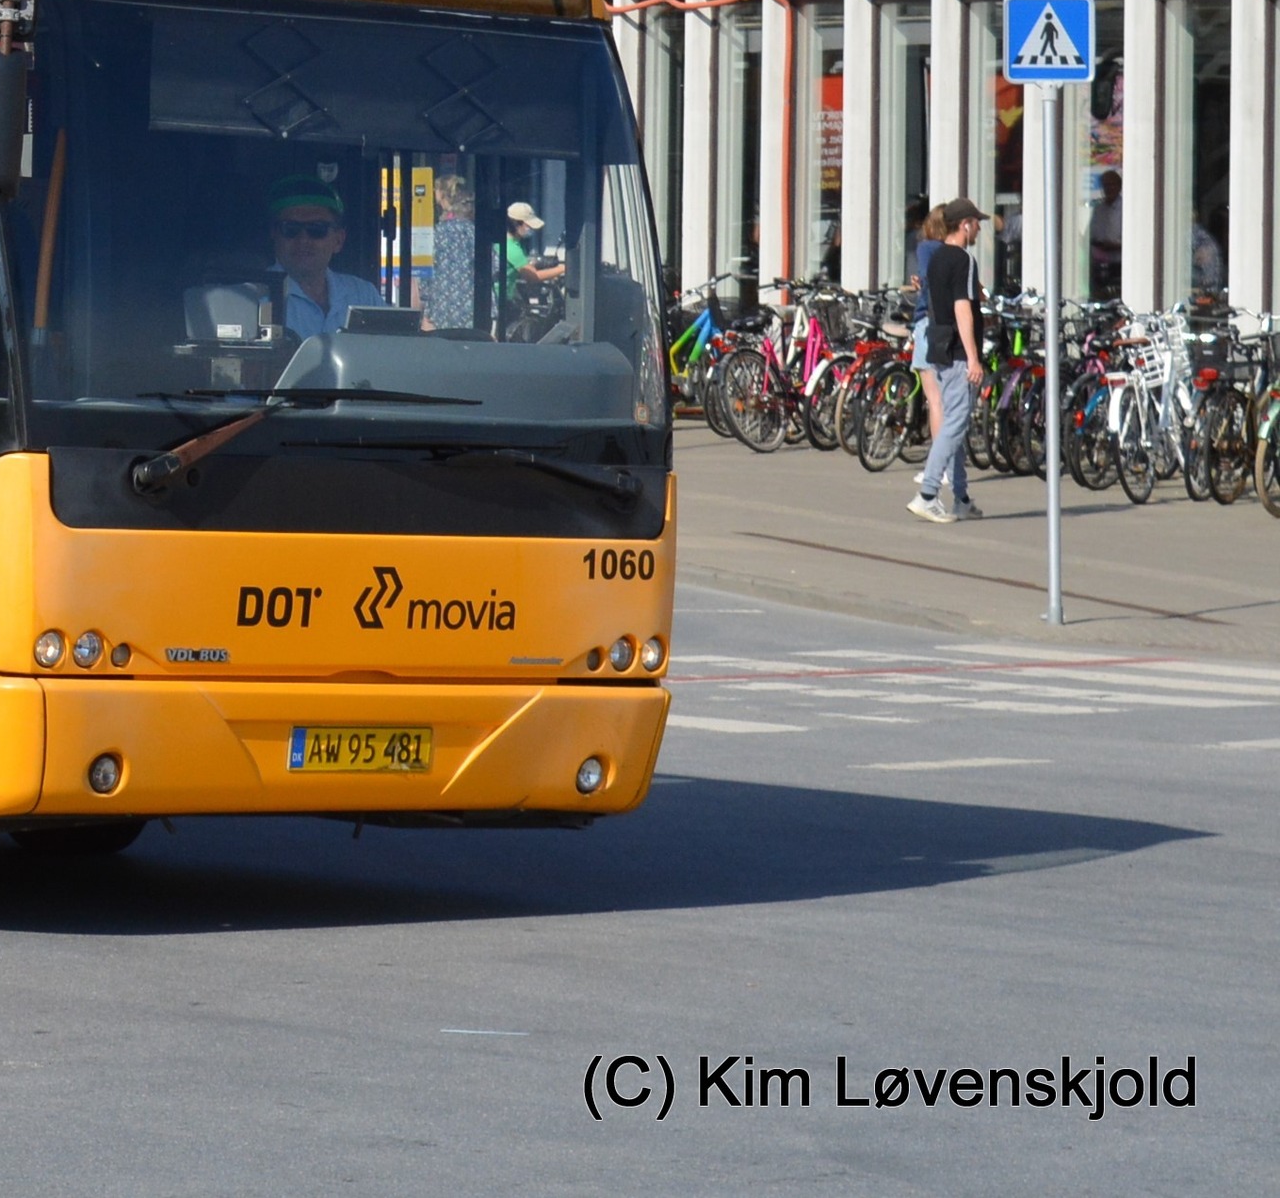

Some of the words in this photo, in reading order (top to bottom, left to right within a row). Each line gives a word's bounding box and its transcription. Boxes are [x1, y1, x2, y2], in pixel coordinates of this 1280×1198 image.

[583, 549, 655, 580] 1060
[236, 586, 322, 627] DOT
[407, 589, 516, 631] movia
[166, 648, 197, 663] VDL
[198, 648, 230, 663] BUS
[292, 752, 302, 762] DK
[308, 733, 342, 763] AW
[348, 733, 377, 765] 95
[384, 732, 422, 764] 481
